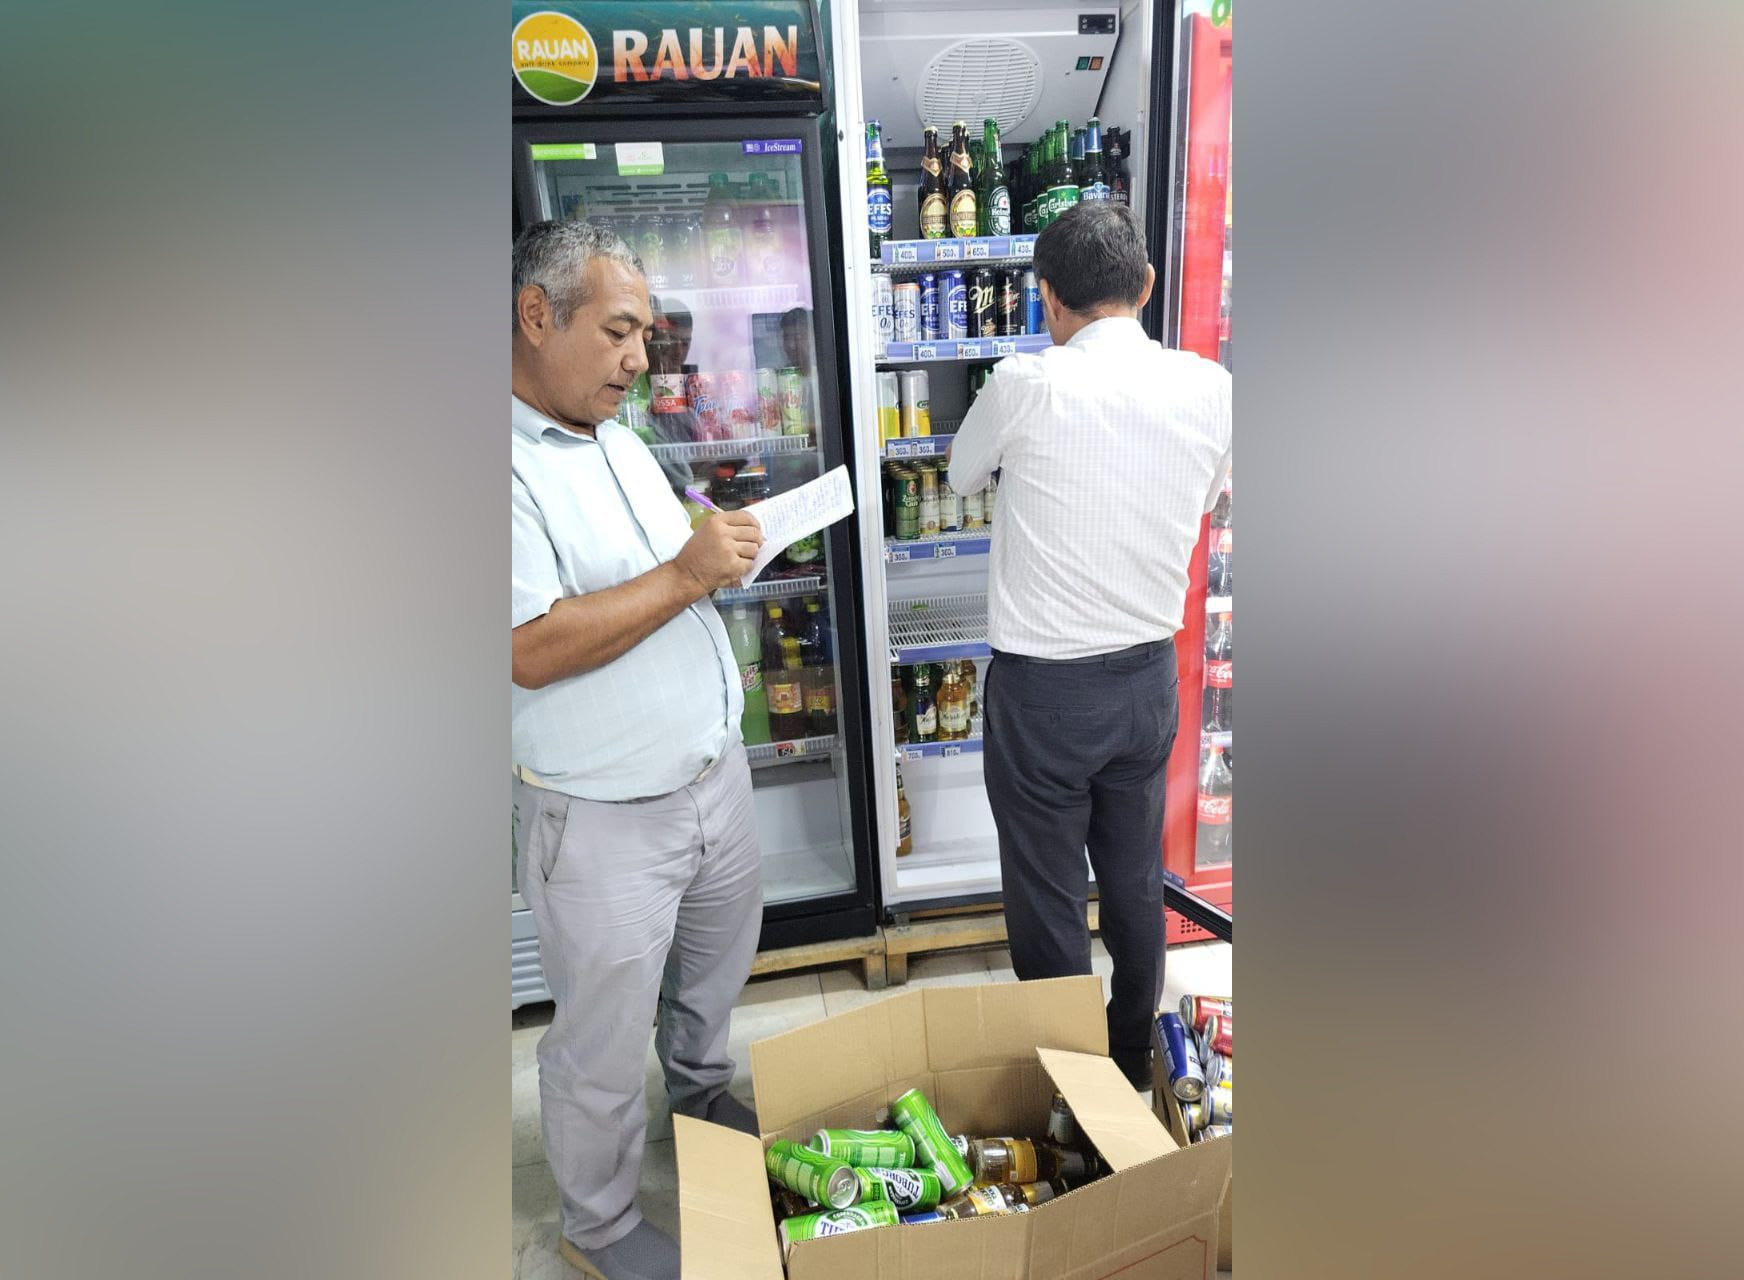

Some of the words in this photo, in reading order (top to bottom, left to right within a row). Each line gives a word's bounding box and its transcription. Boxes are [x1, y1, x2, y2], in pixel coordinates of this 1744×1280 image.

[517, 38, 588, 60] RAUAN
[613, 25, 797, 82] RAUAN
[764, 142, 796, 152] IceStream
[868, 203, 892, 215] EFES
